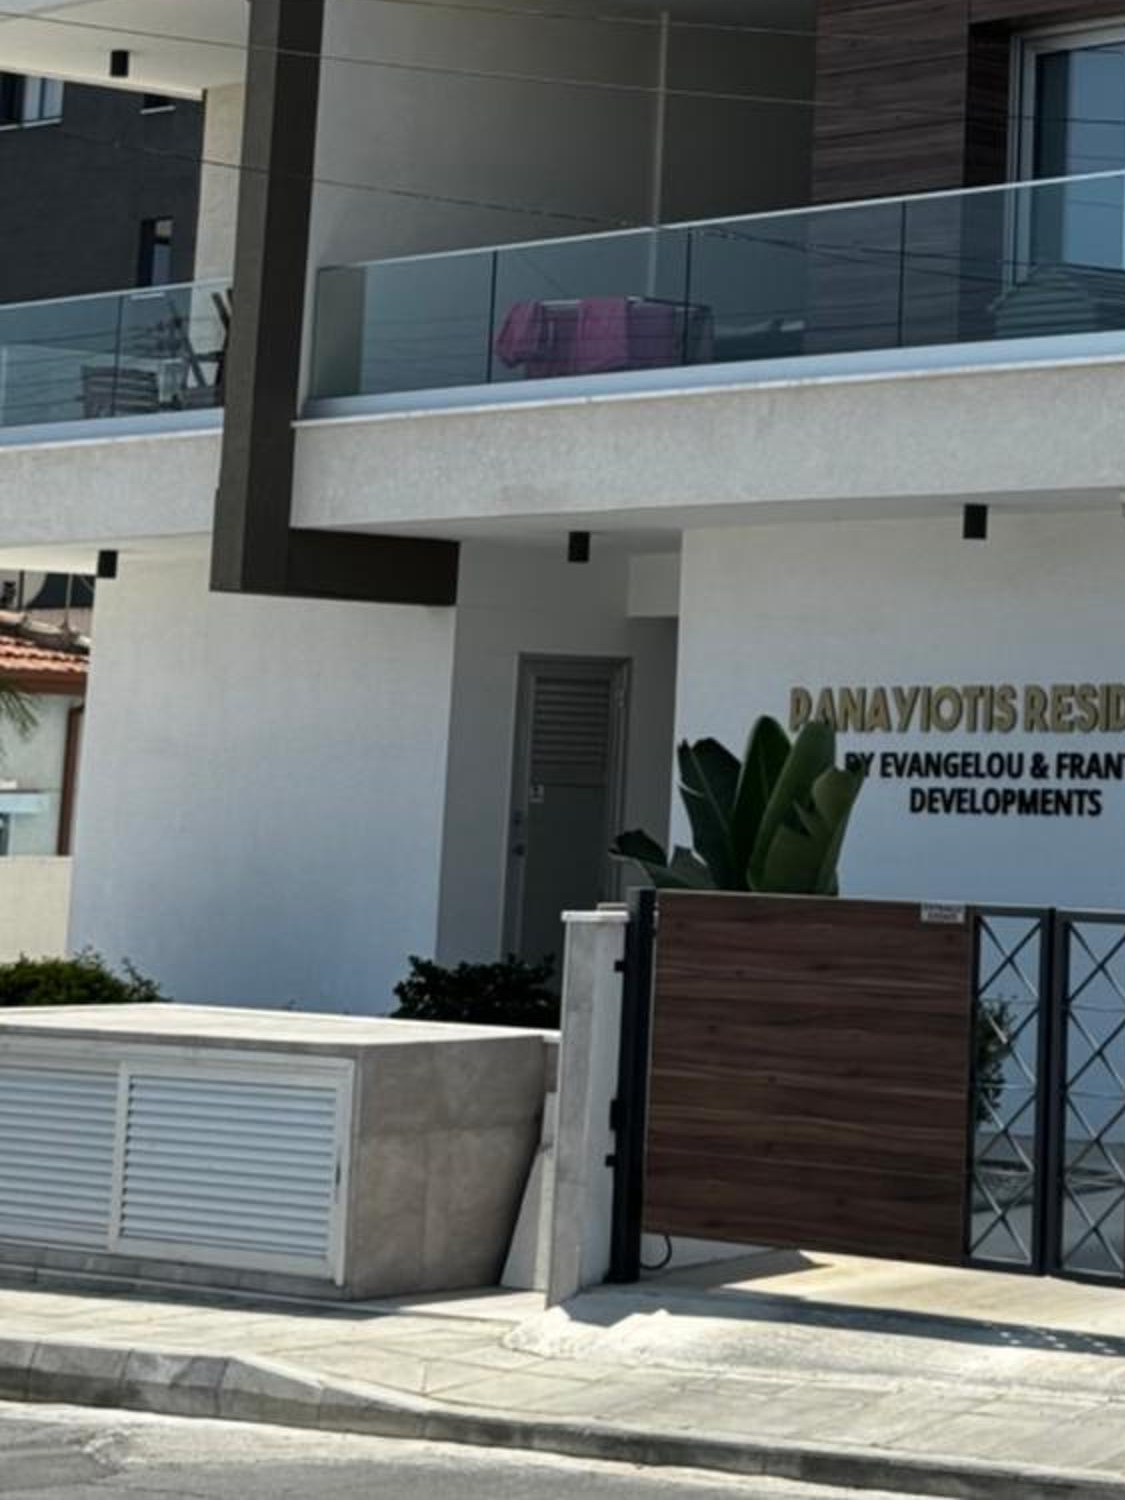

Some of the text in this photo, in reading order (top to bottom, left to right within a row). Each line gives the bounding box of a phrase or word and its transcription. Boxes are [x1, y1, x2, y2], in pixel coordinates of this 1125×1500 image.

[789, 684, 1018, 734] PANAYIOTIS
[879, 752, 1025, 780] EVANGELOU
[1030, 752, 1049, 780] &
[909, 786, 1103, 817] DEVELOPMENTS
